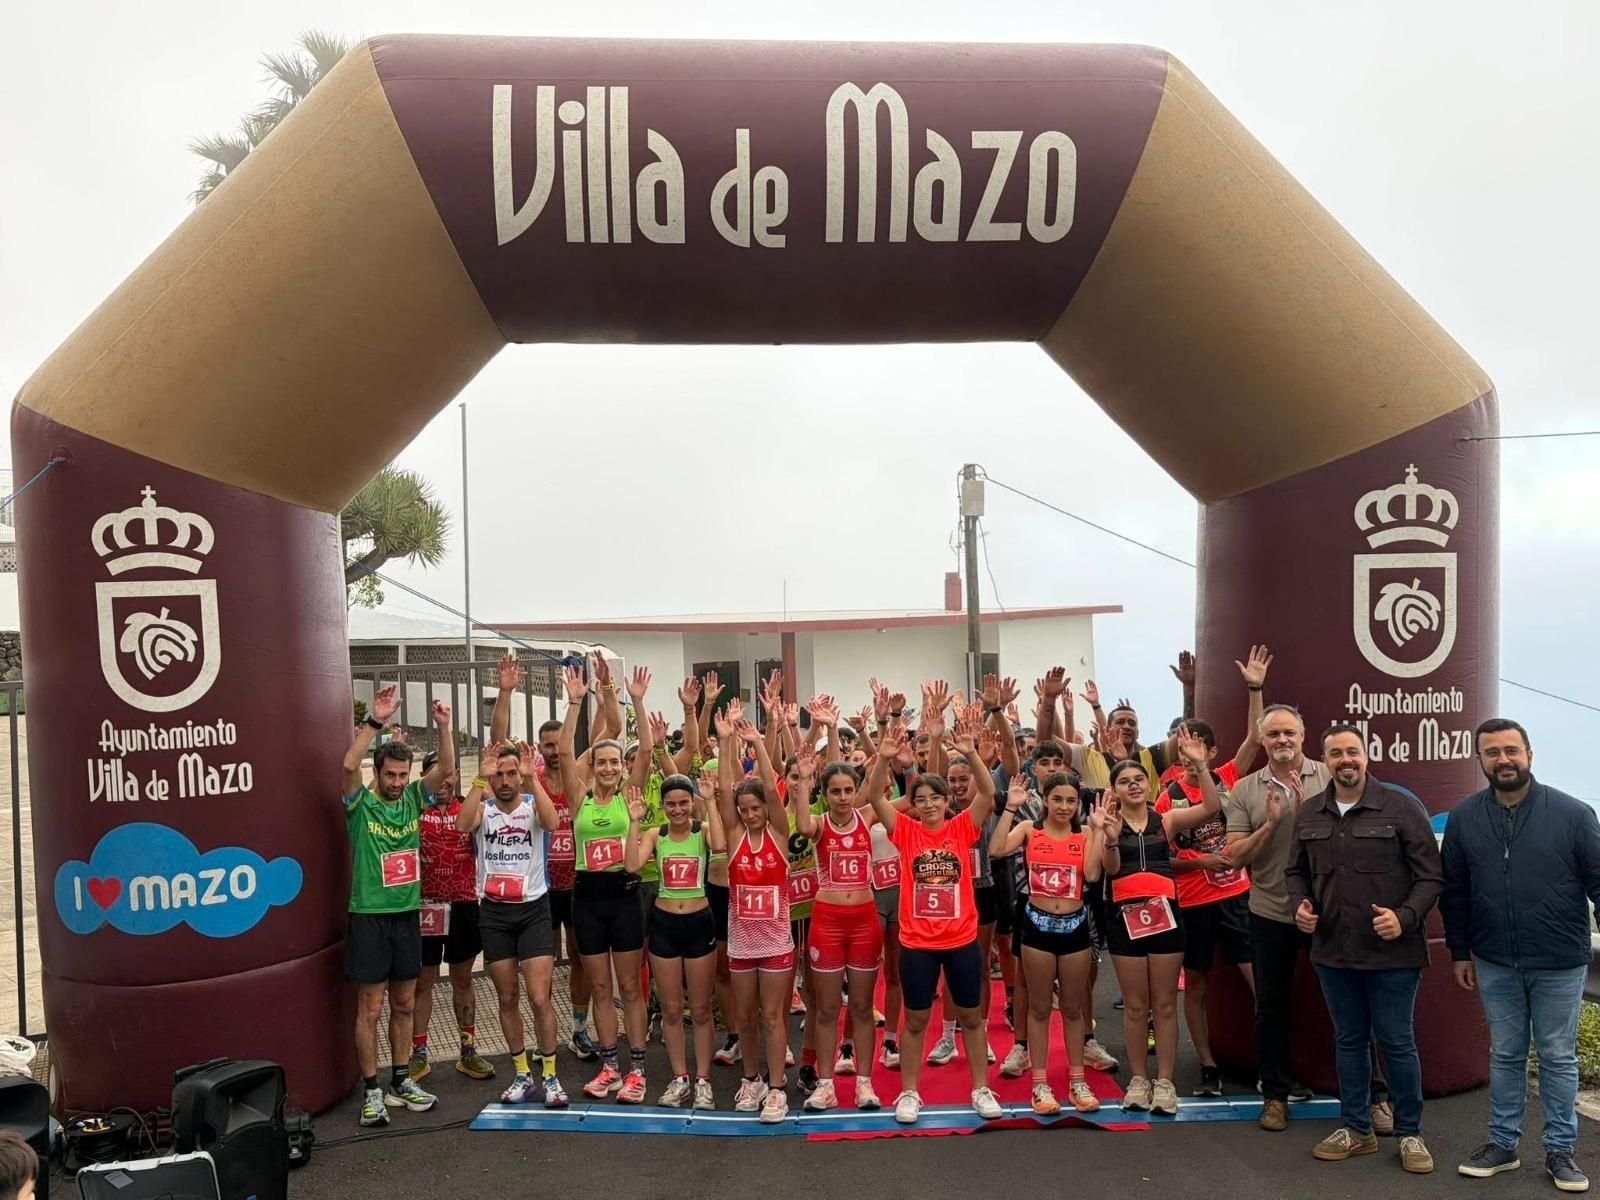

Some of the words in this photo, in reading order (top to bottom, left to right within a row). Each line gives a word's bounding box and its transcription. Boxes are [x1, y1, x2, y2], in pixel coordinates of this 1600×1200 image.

[492, 84, 686, 247] Villa
[710, 128, 790, 248] de
[825, 81, 1078, 244] Mazo
[1345, 682, 1463, 719] Ayuntamiento
[99, 718, 237, 757] Ayuntamiento
[1389, 732, 1410, 762] de
[1418, 717, 1472, 761] Mazo
[87, 758, 139, 802] Villa
[145, 769, 169, 801] de
[178, 752, 254, 799] Mazo
[552, 838, 571, 852] 45
[592, 844, 612, 860] 41
[397, 859, 407, 874] 3
[669, 863, 689, 879] 17
[839, 859, 859, 875] 16
[879, 863, 897, 880] 15
[919, 862, 954, 872] CROSS
[791, 877, 810, 894] 10
[1040, 871, 1061, 888] 14
[74, 876, 82, 911] I
[497, 881, 506, 896] 1
[745, 894, 763, 910] 11
[928, 893, 939, 909] 5
[1140, 909, 1152, 925] 6
